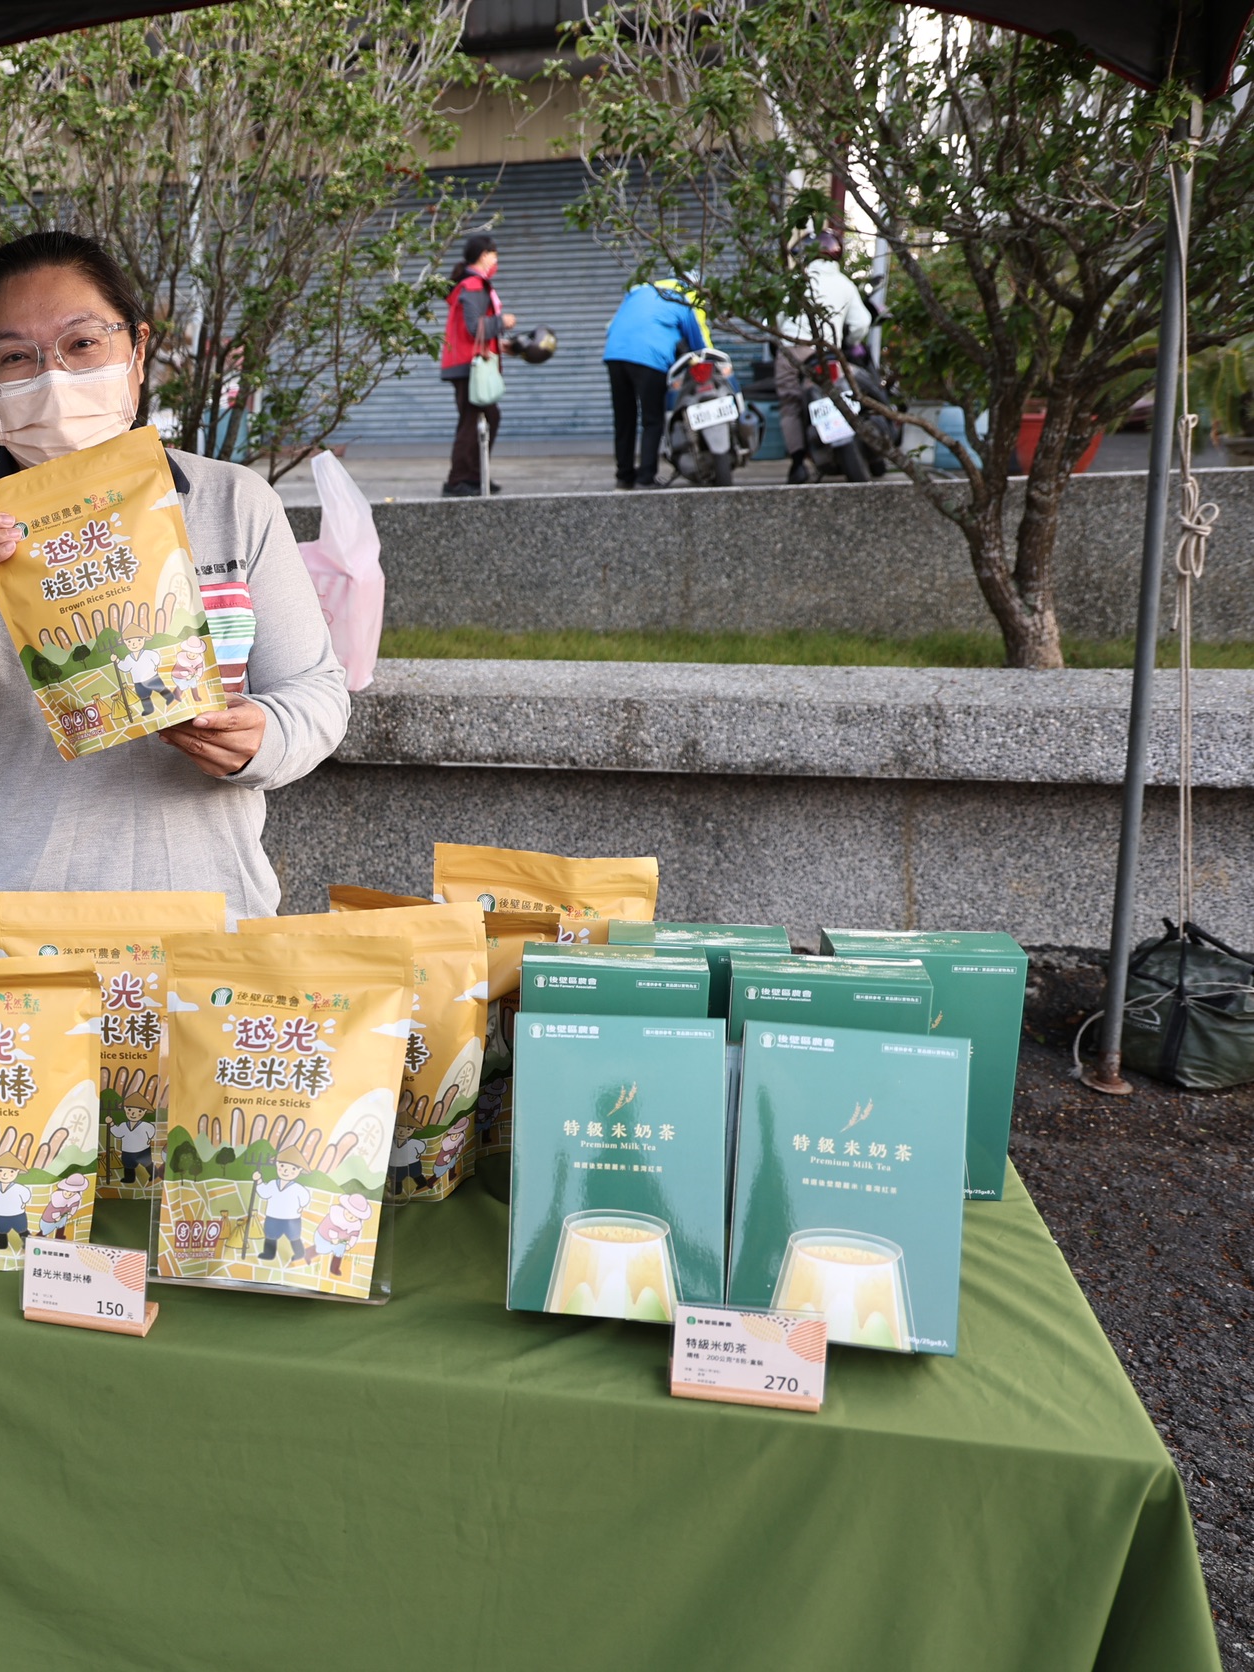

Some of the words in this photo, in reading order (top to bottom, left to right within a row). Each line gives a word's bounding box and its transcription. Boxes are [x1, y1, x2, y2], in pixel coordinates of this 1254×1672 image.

[31, 504, 82, 529] 後壁區農會
[43, 521, 113, 565] 越光
[41, 546, 138, 599] 糙米棒
[59, 601, 85, 614] Brown
[86, 594, 104, 604] Rice
[105, 585, 132, 597] Sticks
[499, 897, 555, 913] 後壁區農會
[549, 976, 597, 985] 後壁區農會
[101, 972, 142, 1009] 光
[761, 988, 812, 998] 後壁區農會
[236, 992, 300, 1007] 後壁區農會
[101, 1010, 161, 1049] 米棒
[234, 1016, 317, 1052] 越光
[546, 1025, 599, 1035] 後壁區農會
[778, 1035, 835, 1047] 後壁區農會
[119, 1051, 148, 1060] Sticks
[216, 1055, 332, 1096] 糙米棒
[223, 1096, 253, 1105] Brown
[256, 1097, 277, 1106] Rice
[279, 1098, 311, 1109] Sticks
[563, 1120, 675, 1141] 特級米奶茶
[580, 1140, 618, 1149] Premium
[620, 1142, 640, 1150] Milk
[642, 1143, 656, 1151] Tea
[792, 1134, 912, 1162] 特級米奶茶
[810, 1155, 850, 1168] Premium
[853, 1160, 874, 1170] Milk
[876, 1162, 891, 1171] Tea
[42, 1250, 70, 1258] 後壁區農會
[32, 1267, 92, 1284] 越光米糙米棒
[96, 1300, 124, 1317] 150
[127, 1312, 134, 1320] 元
[697, 1319, 732, 1327] 後壁區農會
[686, 1338, 747, 1354] 特級米奶茶
[764, 1374, 799, 1393] 270
